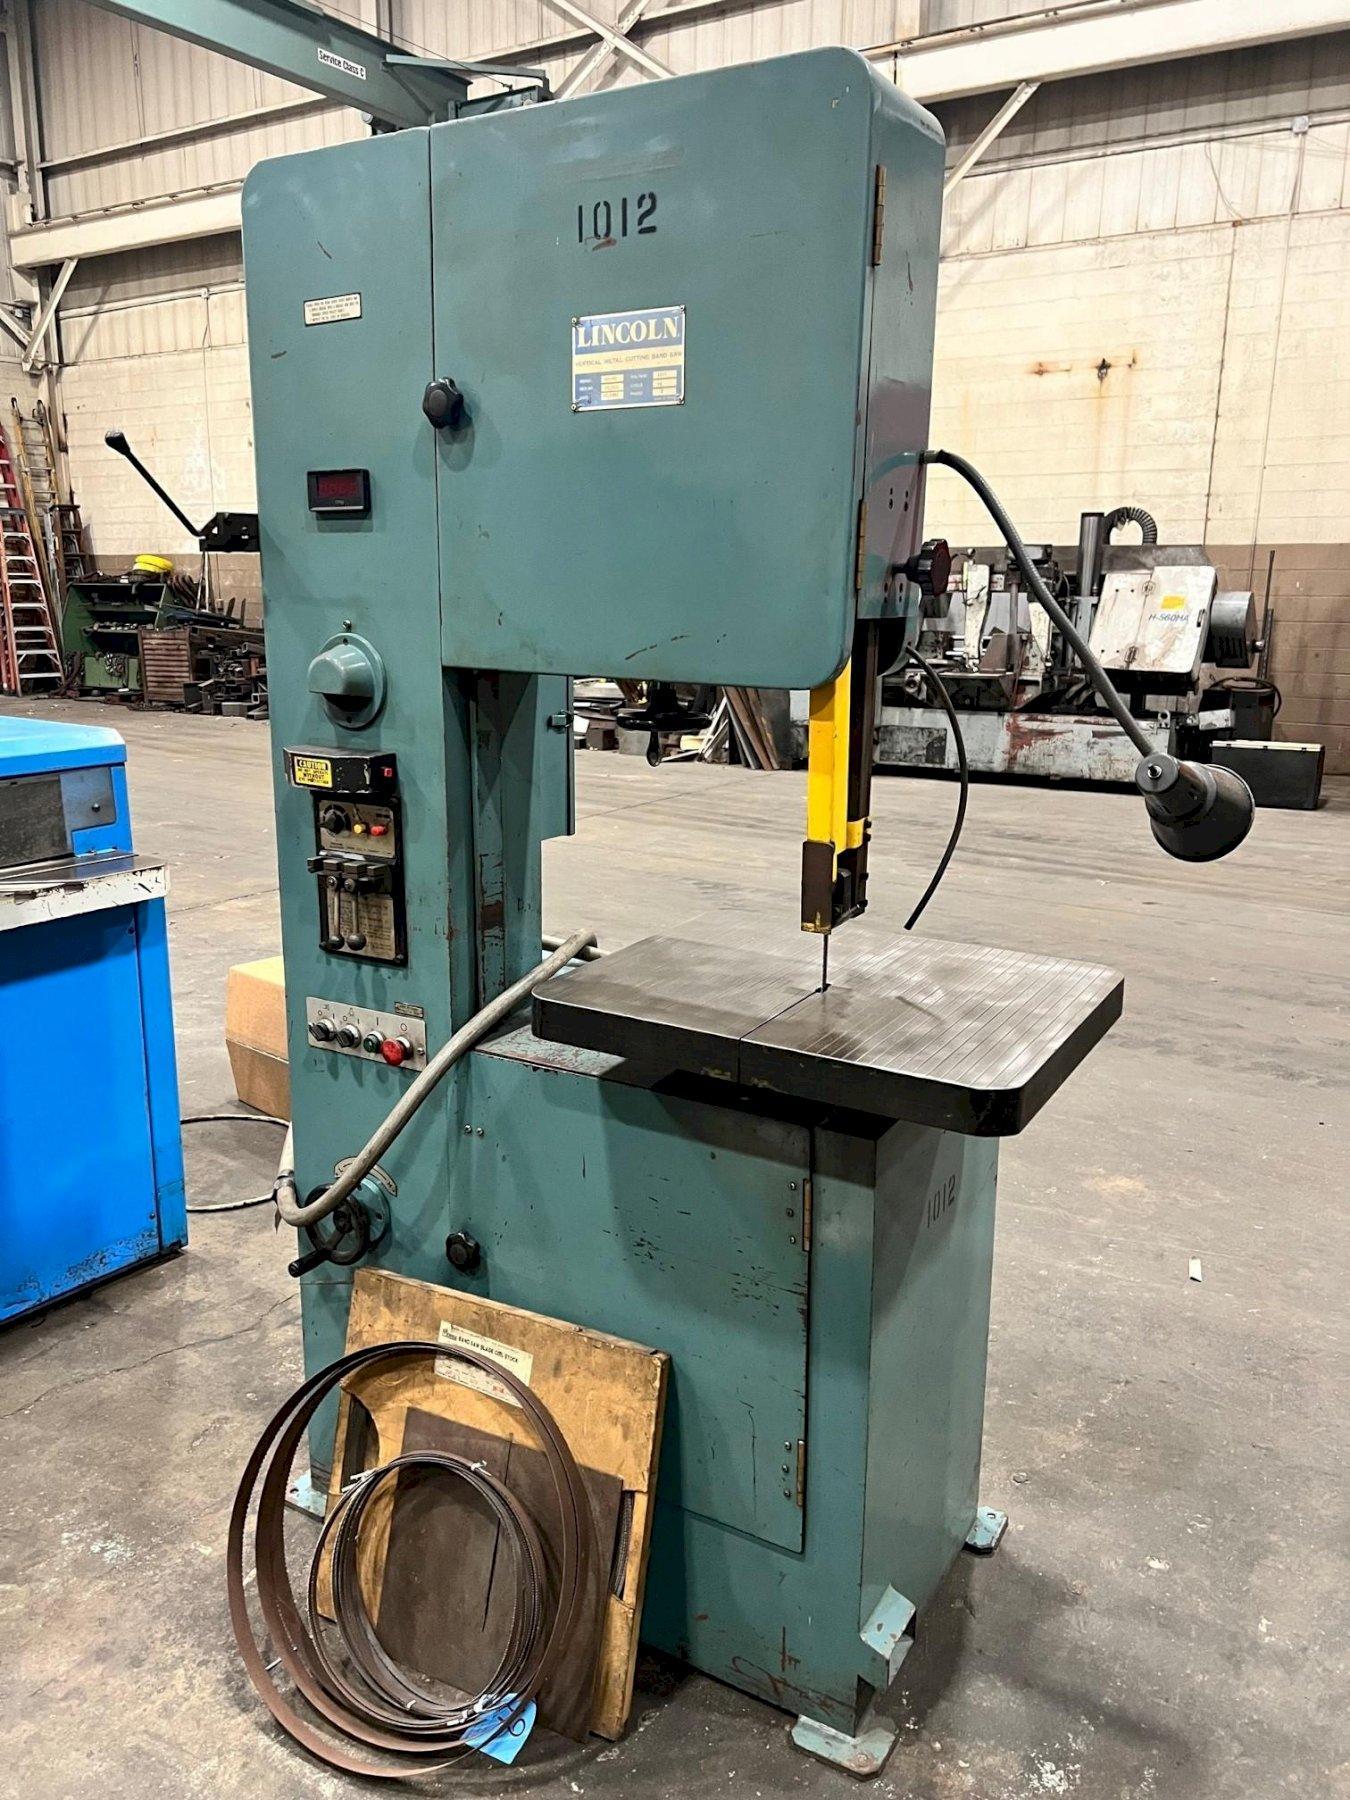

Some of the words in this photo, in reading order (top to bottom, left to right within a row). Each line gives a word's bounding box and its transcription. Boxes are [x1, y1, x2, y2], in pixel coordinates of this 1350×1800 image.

[319, 50, 342, 68] Service
[343, 60, 359, 75] Class
[360, 67, 364, 77] C
[578, 191, 657, 243] 1012
[576, 316, 679, 348] LINCOLN
[625, 354, 650, 363] CUTTING
[651, 352, 668, 360] BAND
[299, 760, 326, 770] CAUTION
[927, 1173, 955, 1228] 1012
[458, 1336, 470, 1346] BAND
[470, 1340, 480, 1349] SAW
[480, 1344, 494, 1354] BLADE
[504, 1353, 519, 1363] STOCK
